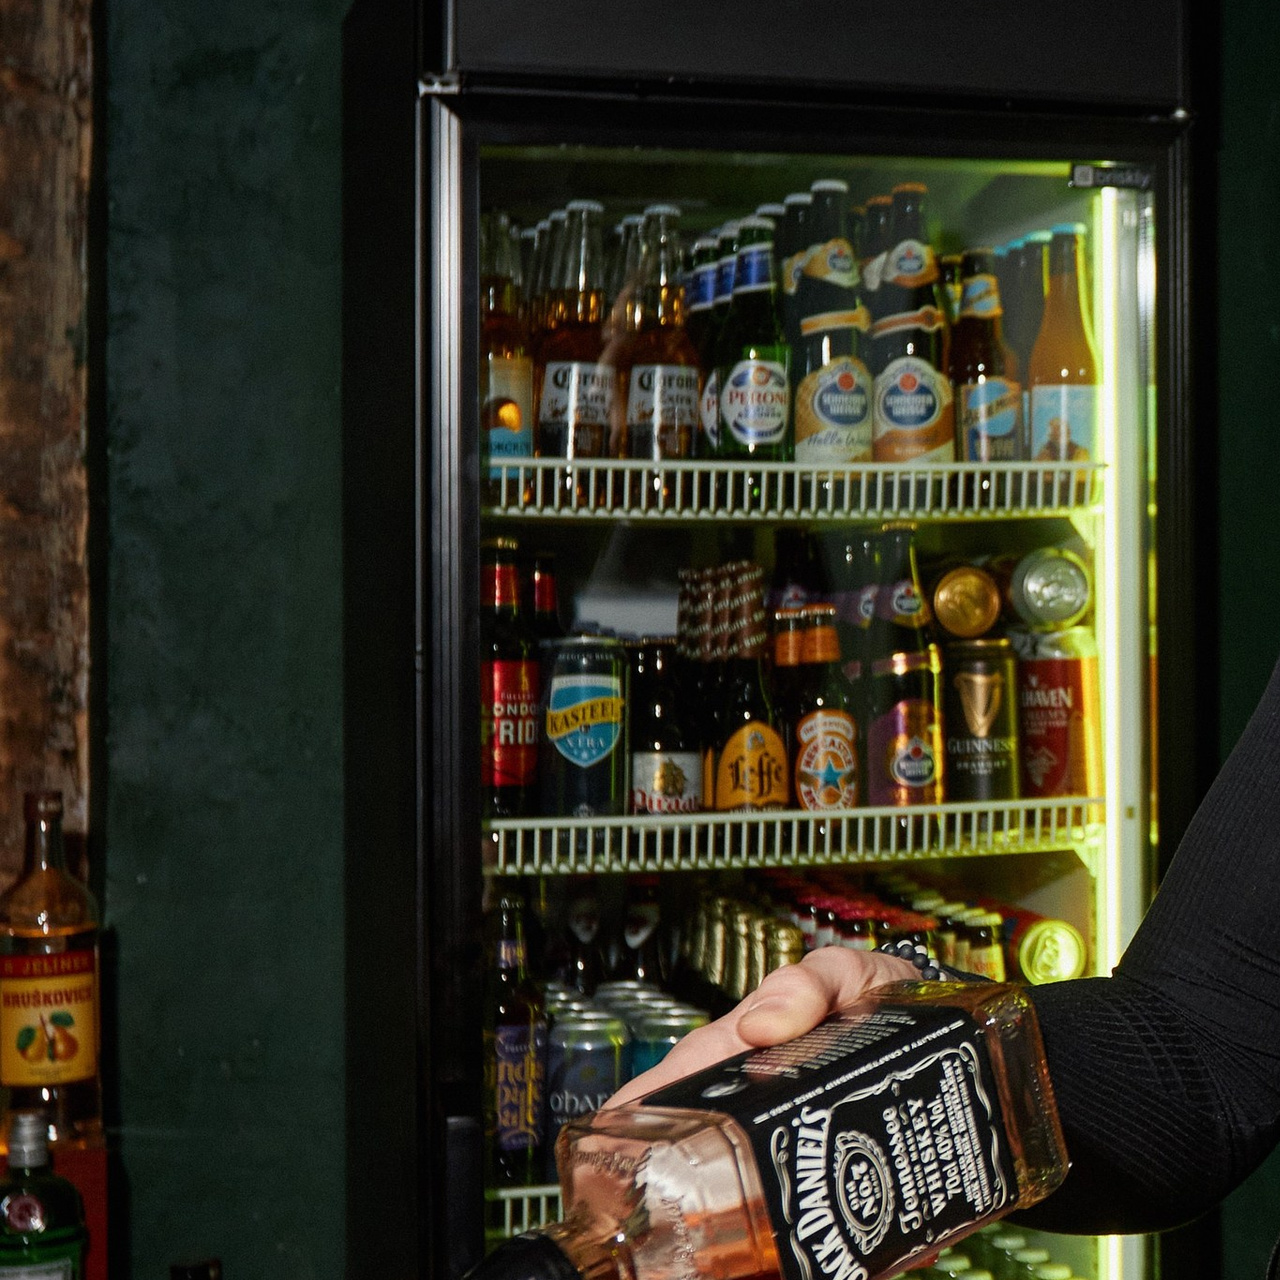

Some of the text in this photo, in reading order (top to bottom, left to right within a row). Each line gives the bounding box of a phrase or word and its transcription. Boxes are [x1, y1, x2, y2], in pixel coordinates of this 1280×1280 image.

[551, 700, 618, 733] KASTEEL
[947, 738, 1014, 754] GUINNESS
[728, 751, 783, 798] Leffe
[911, 1026, 950, 1050] QUALITY
[825, 1048, 904, 1091] CRAFTSMANSHIP
[793, 1086, 825, 1106] SINCE
[942, 1092, 959, 1136] BOTTLED
[906, 1097, 948, 1218] WHISKEY
[926, 1092, 964, 1201] 70cl 40% Vol.
[941, 1059, 985, 1213] JACK DANIEL DISTILLERY
[953, 1134, 964, 1156] AND
[791, 1106, 834, 1242] DANIEL'S
[883, 1105, 923, 1235] Tennessee
[904, 1128, 928, 1196] SOUR MASH
[958, 1154, 974, 1204] DISTILLED
